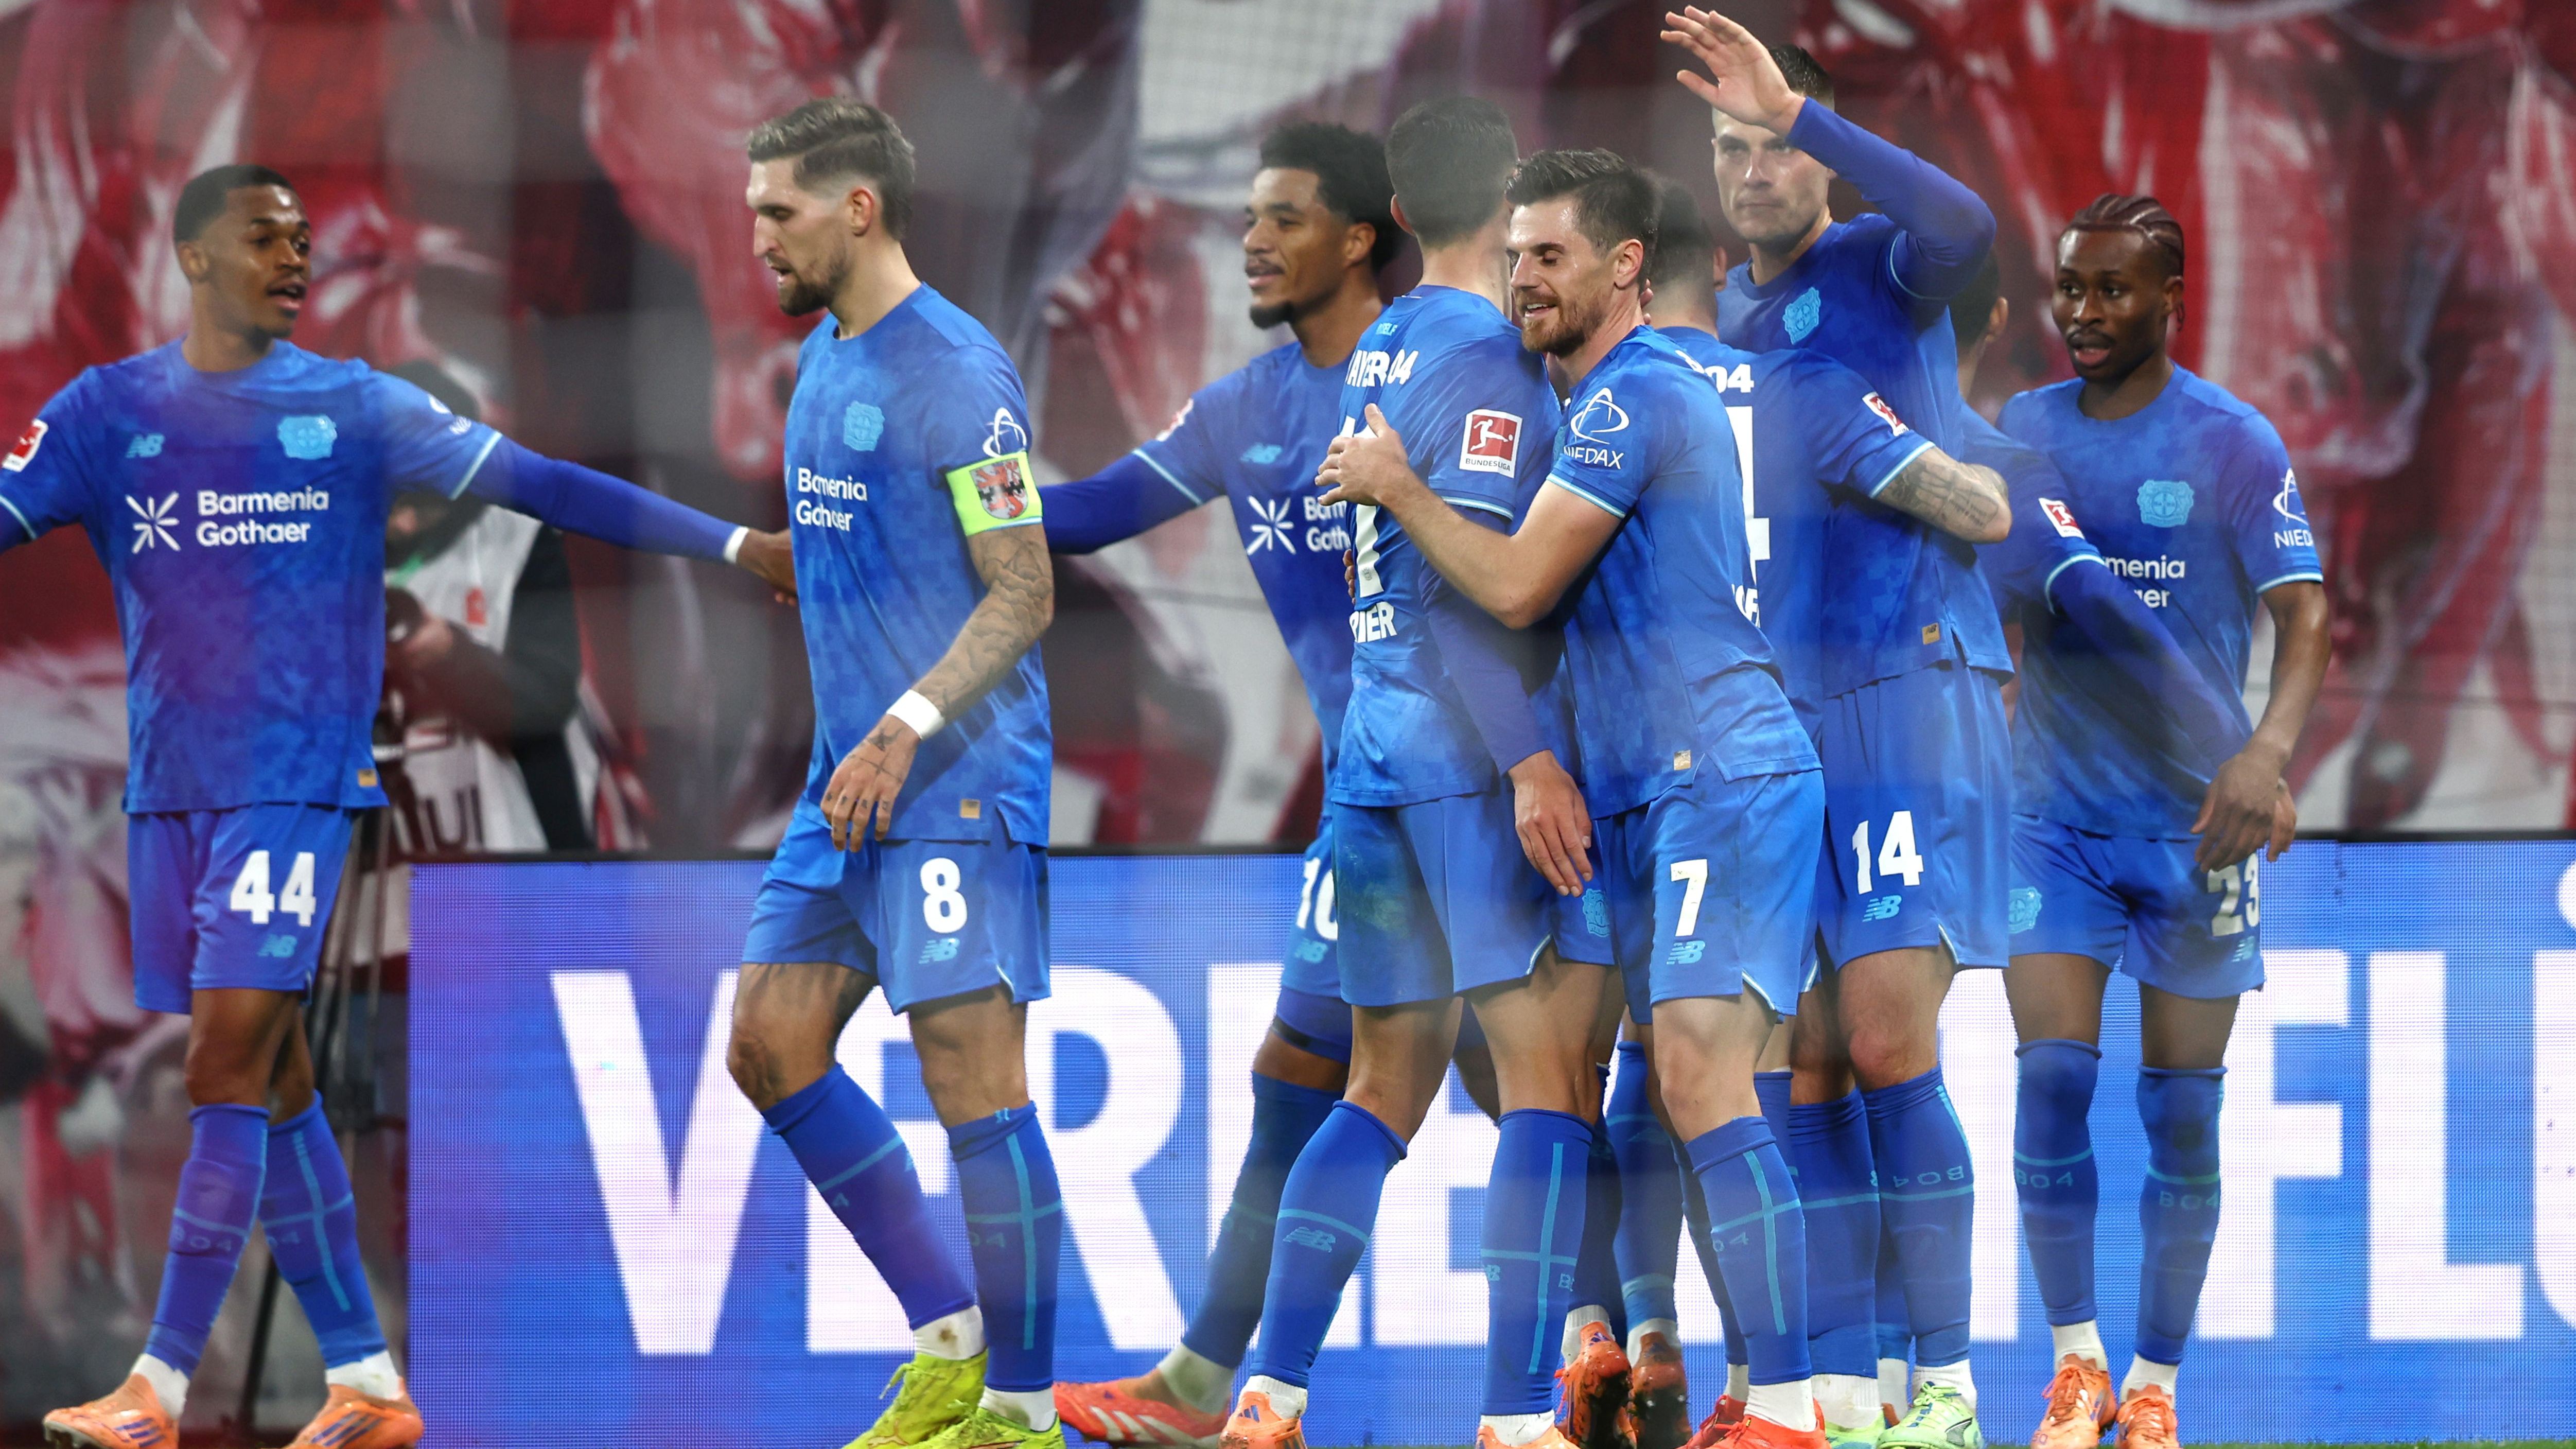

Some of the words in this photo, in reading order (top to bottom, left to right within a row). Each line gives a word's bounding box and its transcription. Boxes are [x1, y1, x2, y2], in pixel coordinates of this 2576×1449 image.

[1345, 350, 1390, 387] AYER
[1387, 349, 1419, 385] 04
[197, 486, 329, 515] Barmenia
[1465, 458, 1511, 472] BUNDESLIGA
[196, 520, 311, 546] Gothaer
[230, 850, 316, 927] 44
[1852, 810, 1924, 894] 14
[920, 858, 968, 933] 8
[1671, 859, 1708, 937] 7
[2207, 852, 2260, 937] 23
